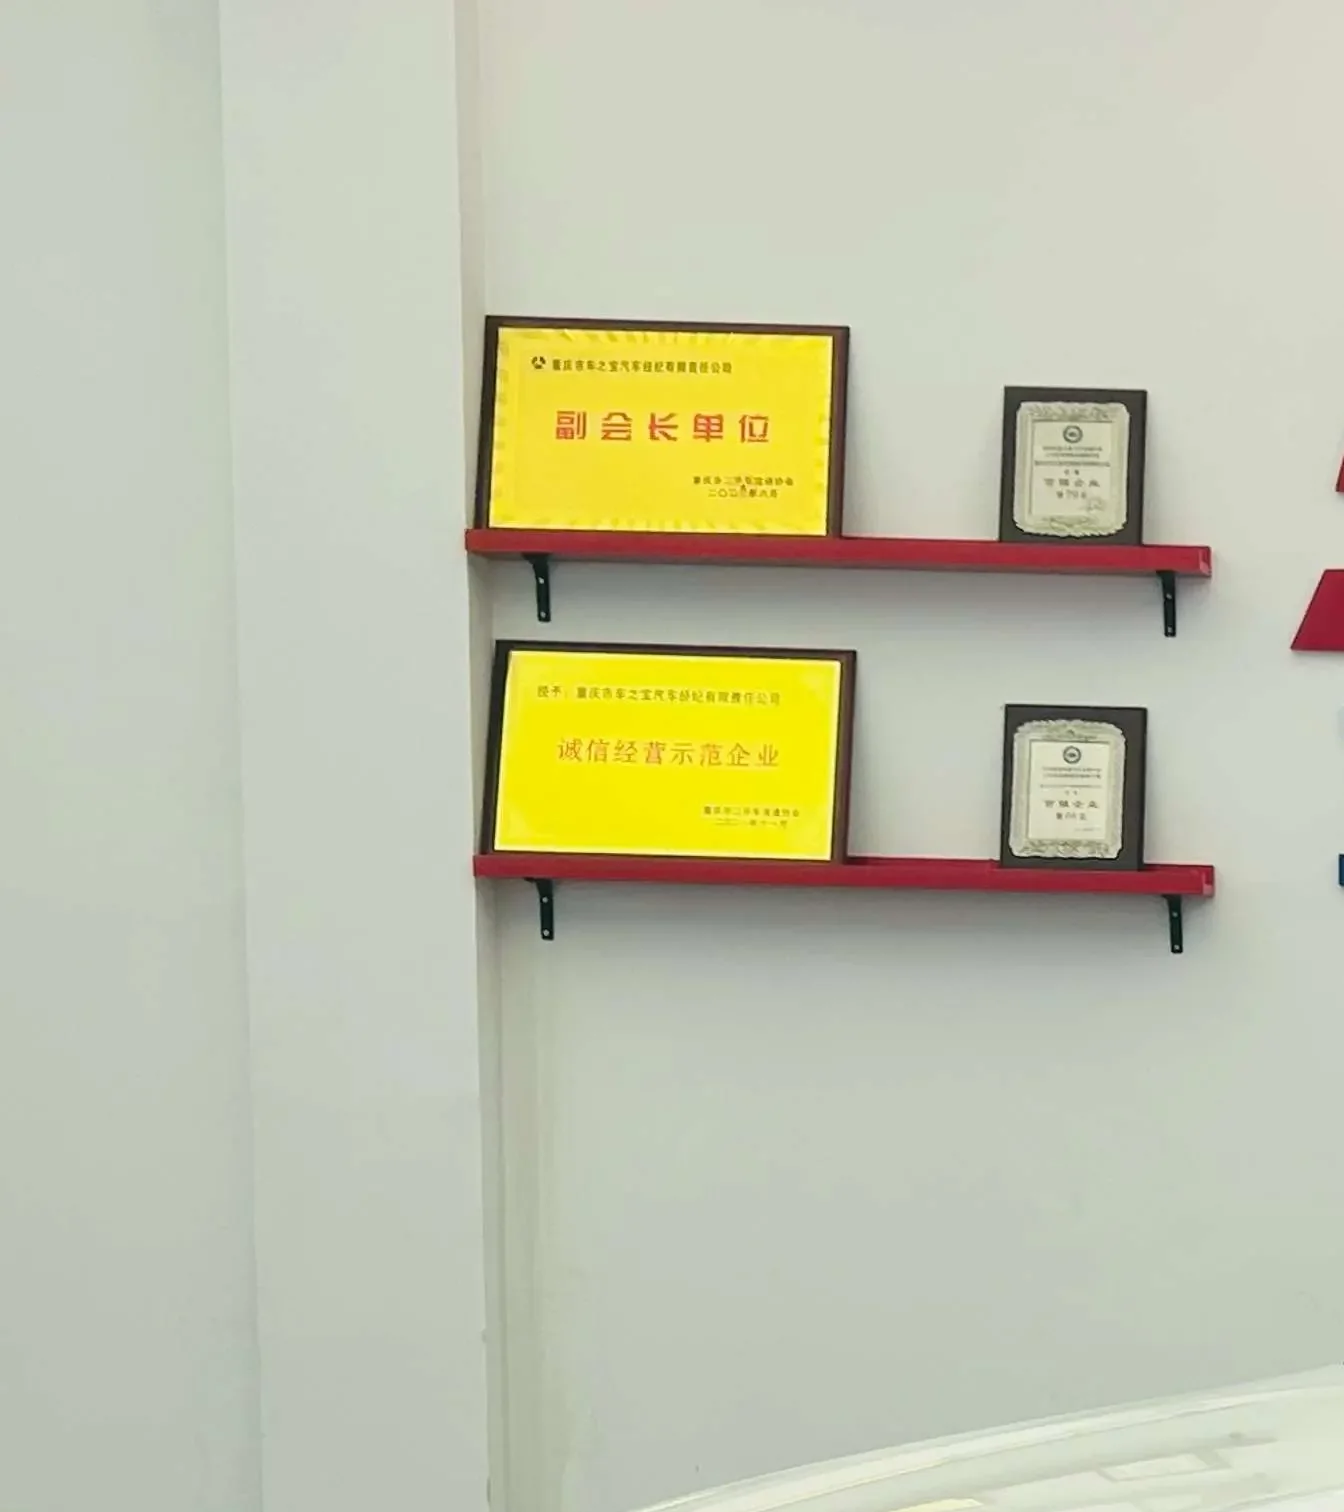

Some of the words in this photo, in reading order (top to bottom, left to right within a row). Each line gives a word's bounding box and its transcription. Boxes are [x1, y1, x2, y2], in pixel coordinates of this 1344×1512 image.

[555, 410, 769, 443] 副会长单位
[556, 737, 780, 768] 诚信经营示范企业
